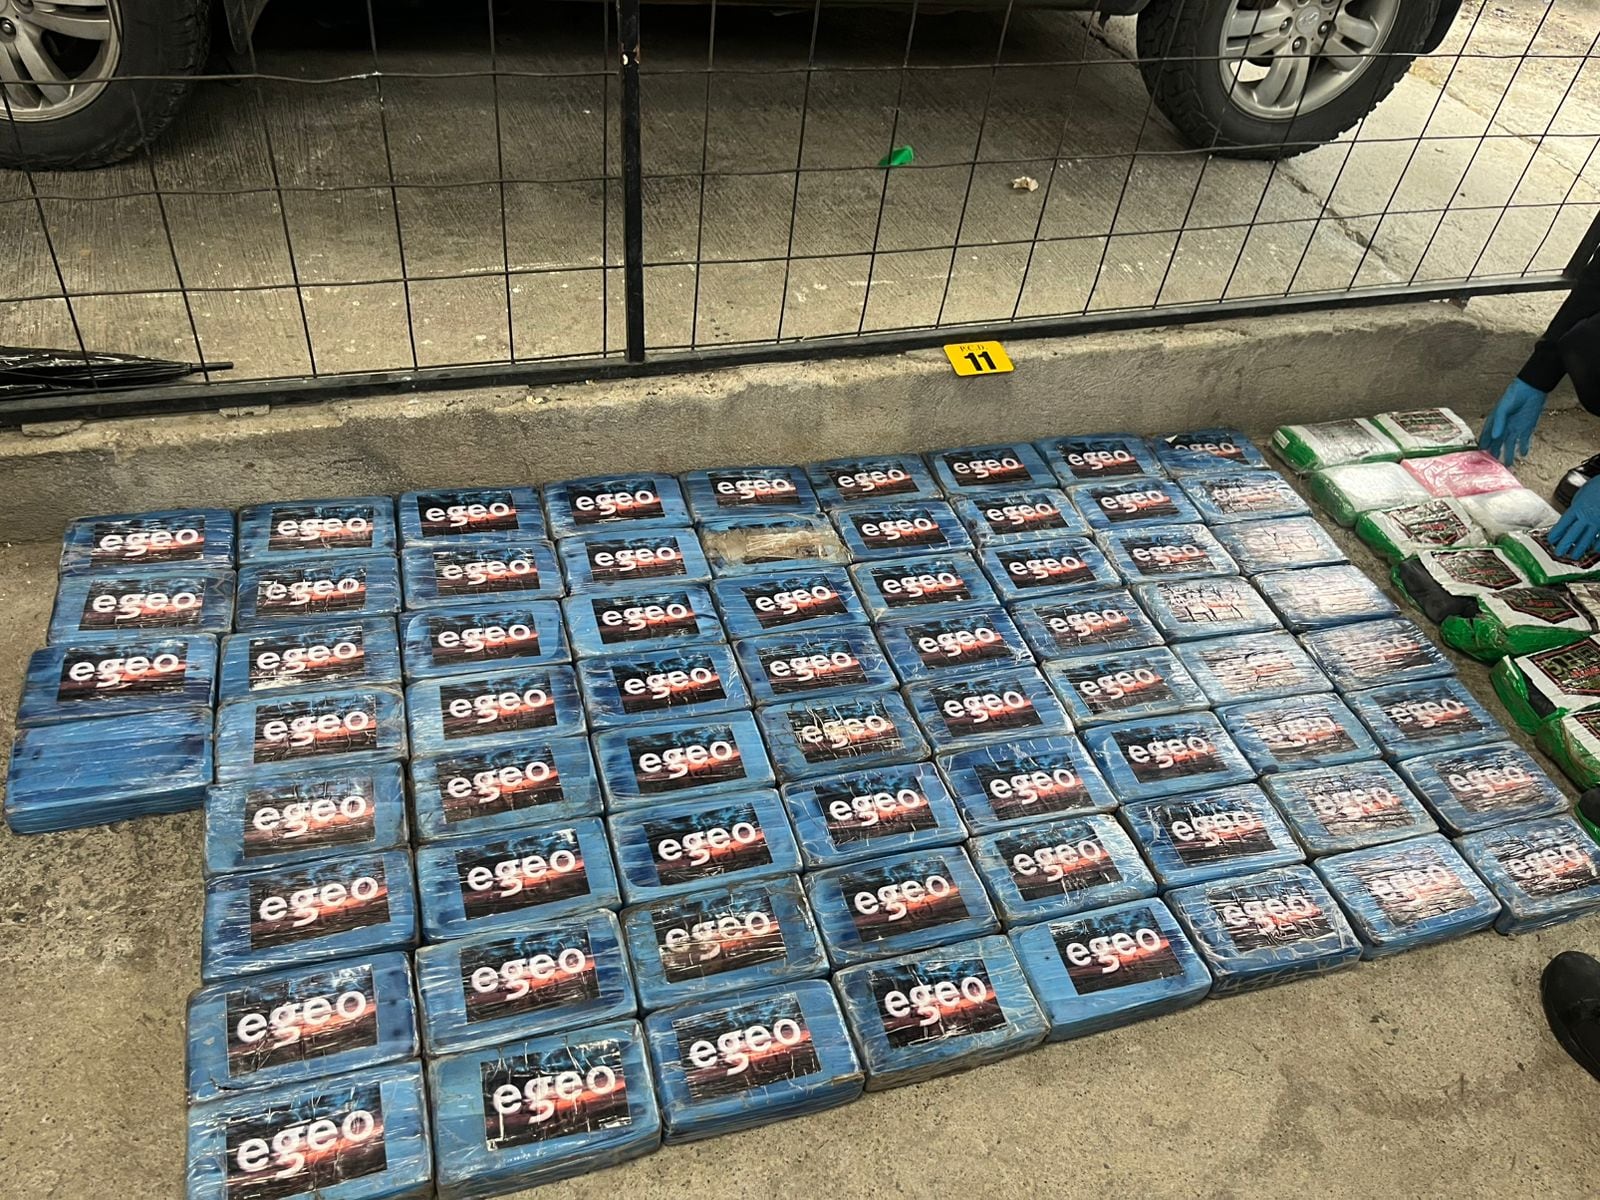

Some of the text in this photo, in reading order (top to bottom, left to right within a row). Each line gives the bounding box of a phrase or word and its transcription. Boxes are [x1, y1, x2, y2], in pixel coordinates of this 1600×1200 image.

[964, 351, 997, 371] 11
[953, 455, 1019, 478] egeo
[1067, 448, 1130, 470] egeo
[717, 476, 791, 500] egeo
[837, 467, 906, 492] egeo
[425, 502, 509, 527] egeo
[576, 488, 654, 515] egeo
[986, 501, 1053, 525] egeo
[1100, 488, 1164, 513] egeo
[99, 529, 199, 556] egeo
[277, 517, 367, 540] egeo
[861, 517, 933, 540] egeo
[594, 546, 676, 571] egeo
[1009, 555, 1081, 579] egeo
[1132, 543, 1200, 565] egeo
[442, 559, 531, 585] egeo
[882, 571, 957, 597] egeo
[92, 592, 196, 620] egeo
[265, 577, 360, 605] egeo
[755, 584, 832, 615] egeo
[602, 603, 687, 631] egeo
[1049, 607, 1123, 637] egeo
[438, 623, 531, 652] egeo
[918, 626, 996, 657] egeo
[69, 653, 179, 687] egeo
[256, 641, 357, 672] egeo
[769, 651, 852, 682] egeo
[624, 667, 712, 700] egeo
[1079, 668, 1156, 700] egeo
[449, 688, 547, 724] egeo
[943, 689, 1025, 724] egeo
[263, 710, 369, 746] egeo
[638, 740, 732, 779] egeo
[1128, 734, 1208, 768] egeo
[447, 760, 550, 803] egeo
[989, 768, 1076, 805] egeo
[253, 795, 366, 837] egeo
[829, 789, 920, 827] egeo
[658, 822, 757, 866] egeo
[467, 850, 576, 897] egeo
[1013, 839, 1101, 881] egeo
[259, 876, 379, 926] egeo
[854, 875, 951, 921] egeo
[665, 911, 770, 960] egeo
[1066, 928, 1161, 973] egeo
[470, 948, 586, 1000] egeo
[884, 976, 987, 1027] egeo
[236, 990, 367, 1048] egeo
[688, 1018, 801, 1075] egeo
[493, 1066, 615, 1124] egeo
[236, 1109, 375, 1178] egeo
